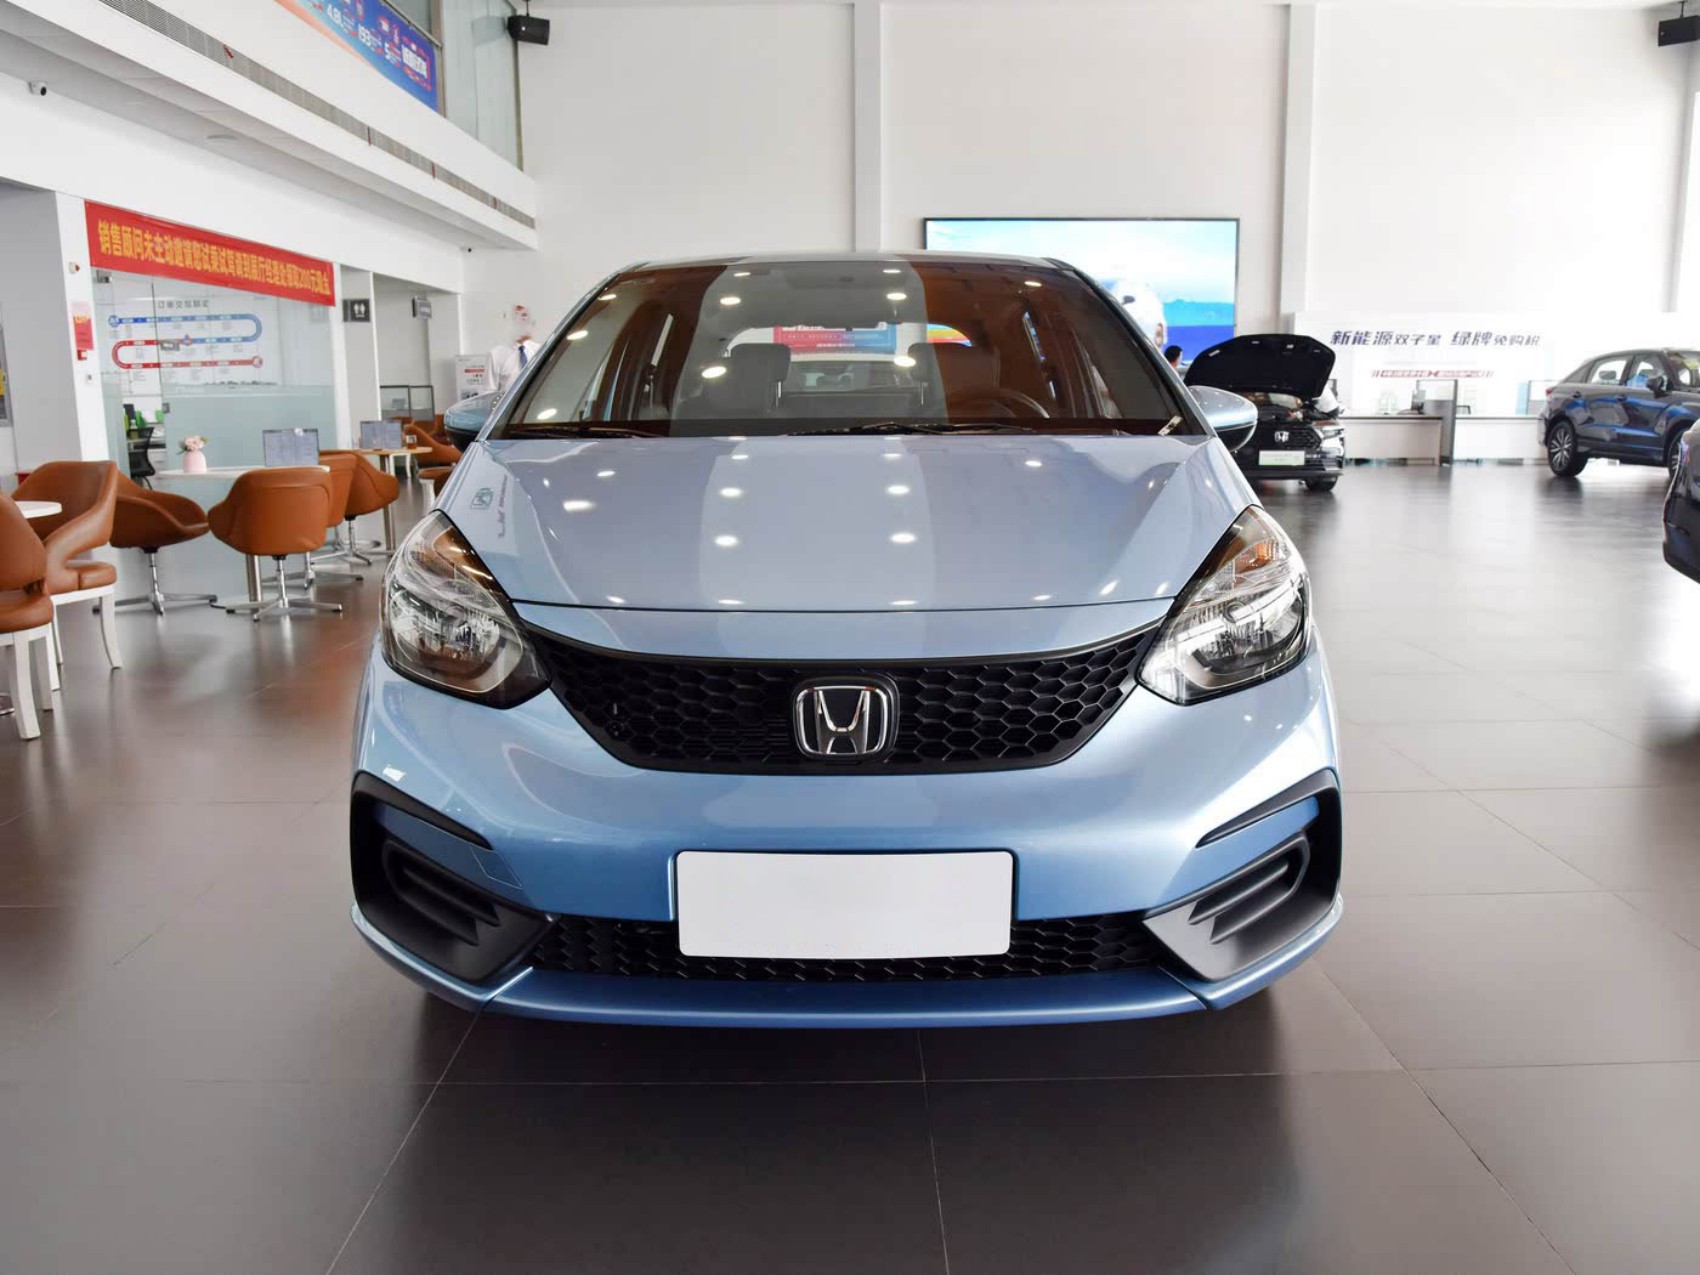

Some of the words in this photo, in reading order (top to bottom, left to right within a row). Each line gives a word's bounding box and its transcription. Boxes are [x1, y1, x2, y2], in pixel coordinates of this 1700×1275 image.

[1331, 330, 1440, 346] 新能源双子星
[1451, 330, 1540, 346] 绿牌免购税
